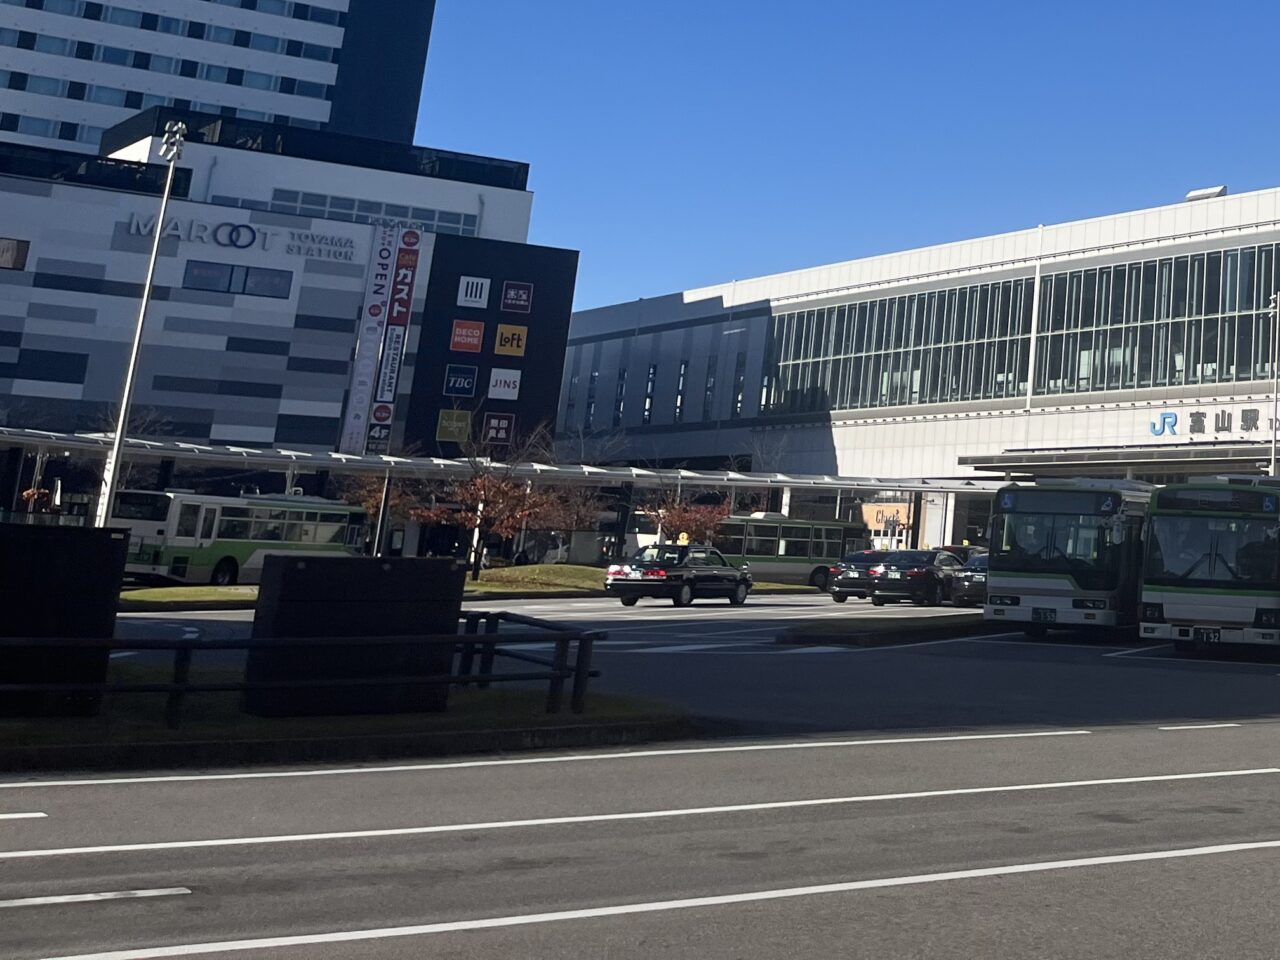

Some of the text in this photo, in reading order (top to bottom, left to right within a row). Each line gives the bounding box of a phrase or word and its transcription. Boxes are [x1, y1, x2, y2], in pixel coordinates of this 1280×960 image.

[129, 212, 278, 251] MAROOT
[289, 231, 354, 249] TOYAMA
[286, 243, 354, 261] STATION
[373, 248, 391, 295] OPEN
[393, 267, 413, 317] ガスト
[454, 336, 479, 344] HOME
[456, 328, 480, 336] DECO
[386, 333, 401, 394] RESTAURANT
[448, 377, 473, 388] TBC
[492, 379, 518, 389] JINS
[1150, 412, 1178, 436] JR
[1189, 409, 1260, 434] 富山駅
[370, 426, 389, 439] 4F
